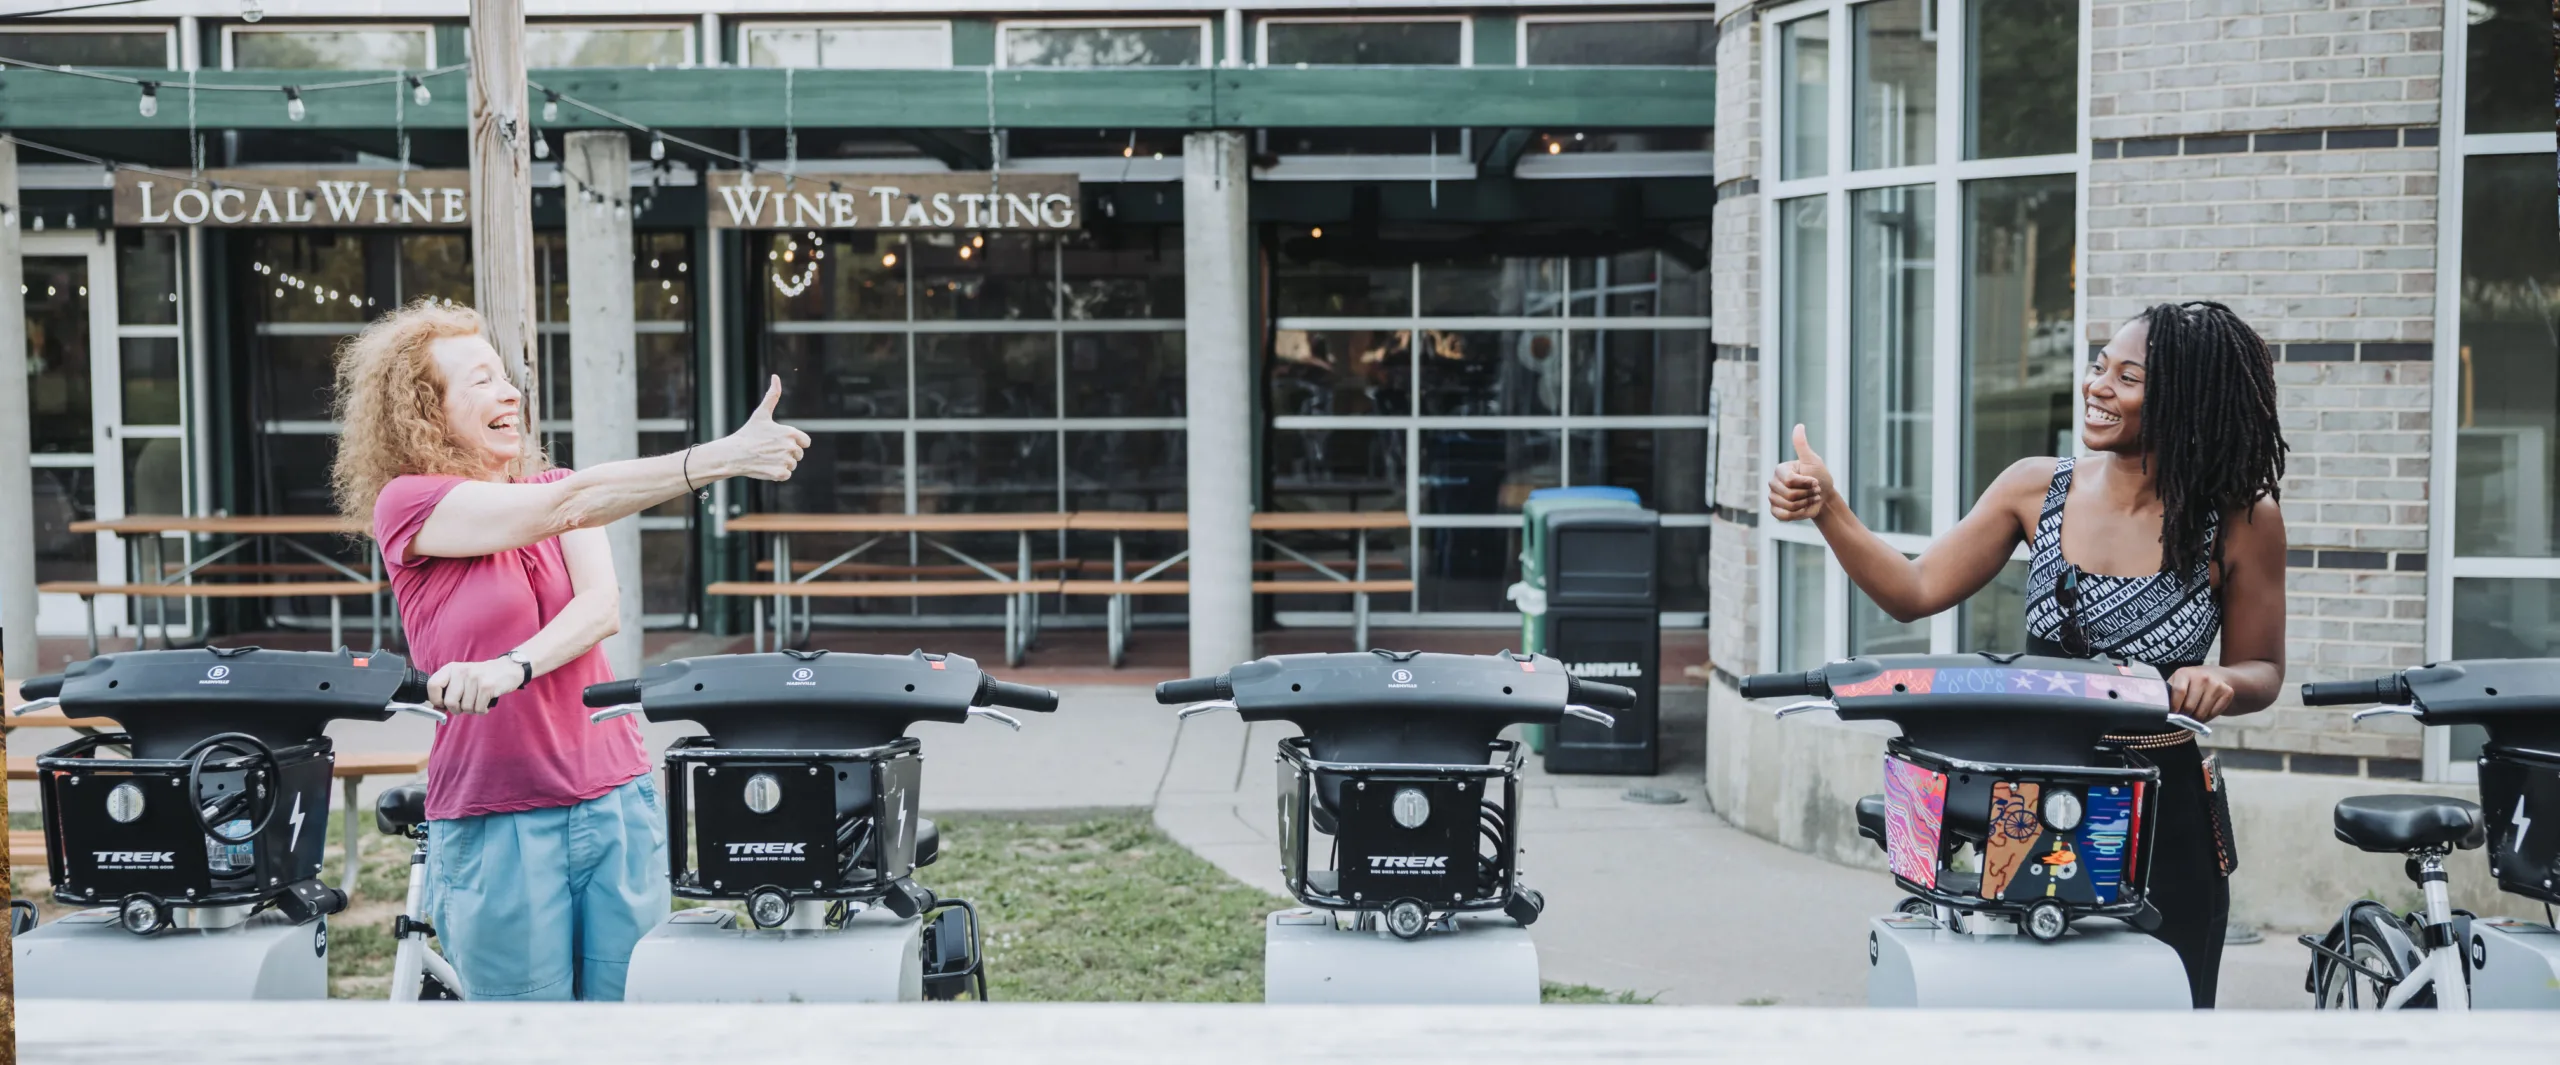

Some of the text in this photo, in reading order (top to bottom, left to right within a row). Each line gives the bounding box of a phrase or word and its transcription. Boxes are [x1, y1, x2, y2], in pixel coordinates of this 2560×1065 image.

[137, 180, 467, 224] LOCAL WINE
[718, 185, 1075, 228] WINE TASTING
[2077, 575, 2098, 595] INK
[2089, 578, 2119, 602] PINK
[2123, 582, 2170, 620] PINK
[2143, 620, 2177, 646] PINK
[2171, 599, 2197, 626] PINK
[2195, 585, 2212, 604] PIN
[2138, 641, 2171, 661] PINK
[2168, 619, 2195, 647] PINK
[1564, 662, 1642, 677] LANDFILL
[92, 851, 175, 863] TREK
[725, 842, 808, 855] TREK
[1367, 856, 1449, 868] TREK
[316, 930, 326, 949] 05
[2473, 943, 2483, 962] 01
